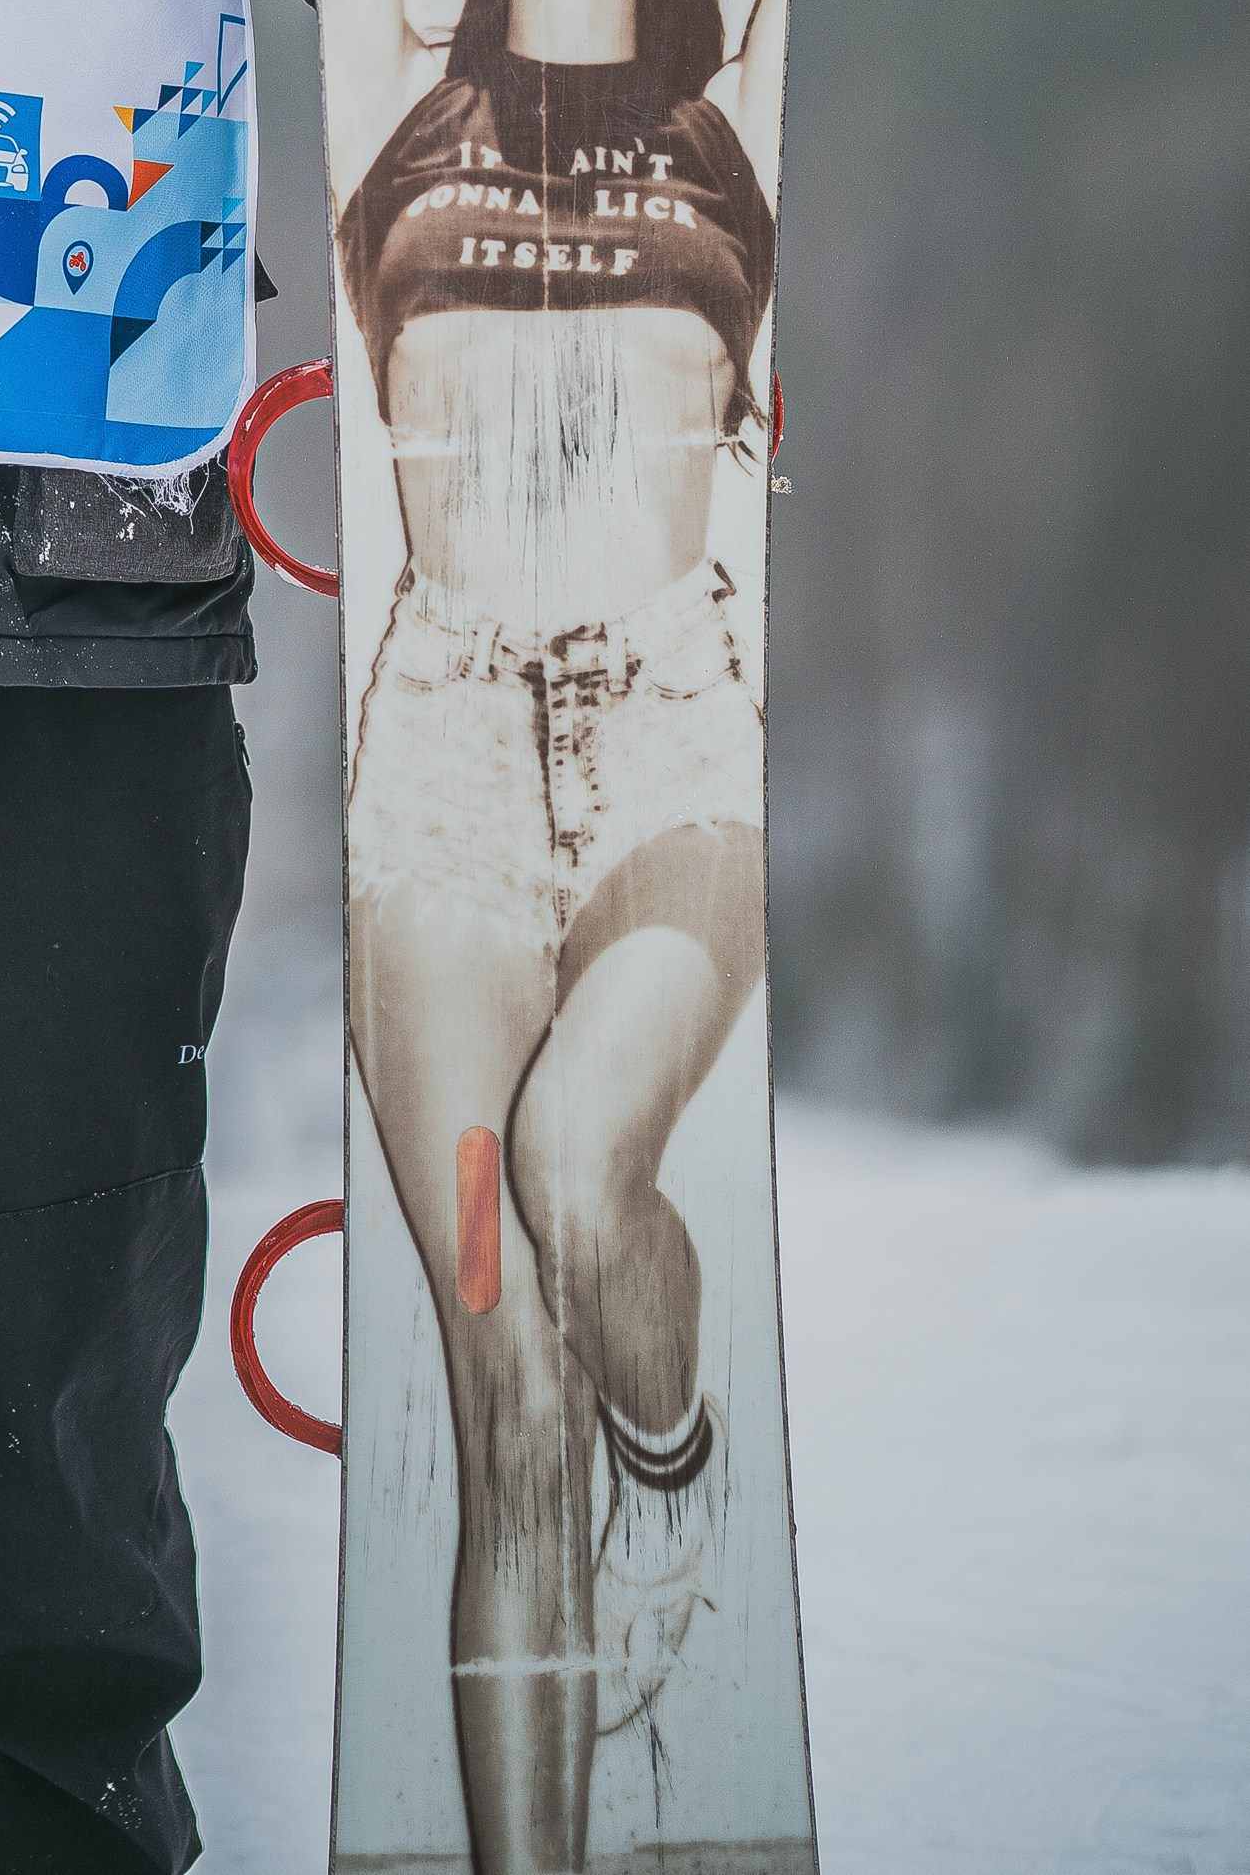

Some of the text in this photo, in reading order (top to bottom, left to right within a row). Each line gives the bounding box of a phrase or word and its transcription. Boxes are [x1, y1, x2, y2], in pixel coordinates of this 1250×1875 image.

[459, 136, 674, 181] IT AIN'T
[594, 189, 698, 230] LICK
[458, 236, 640, 276] ITSELF
